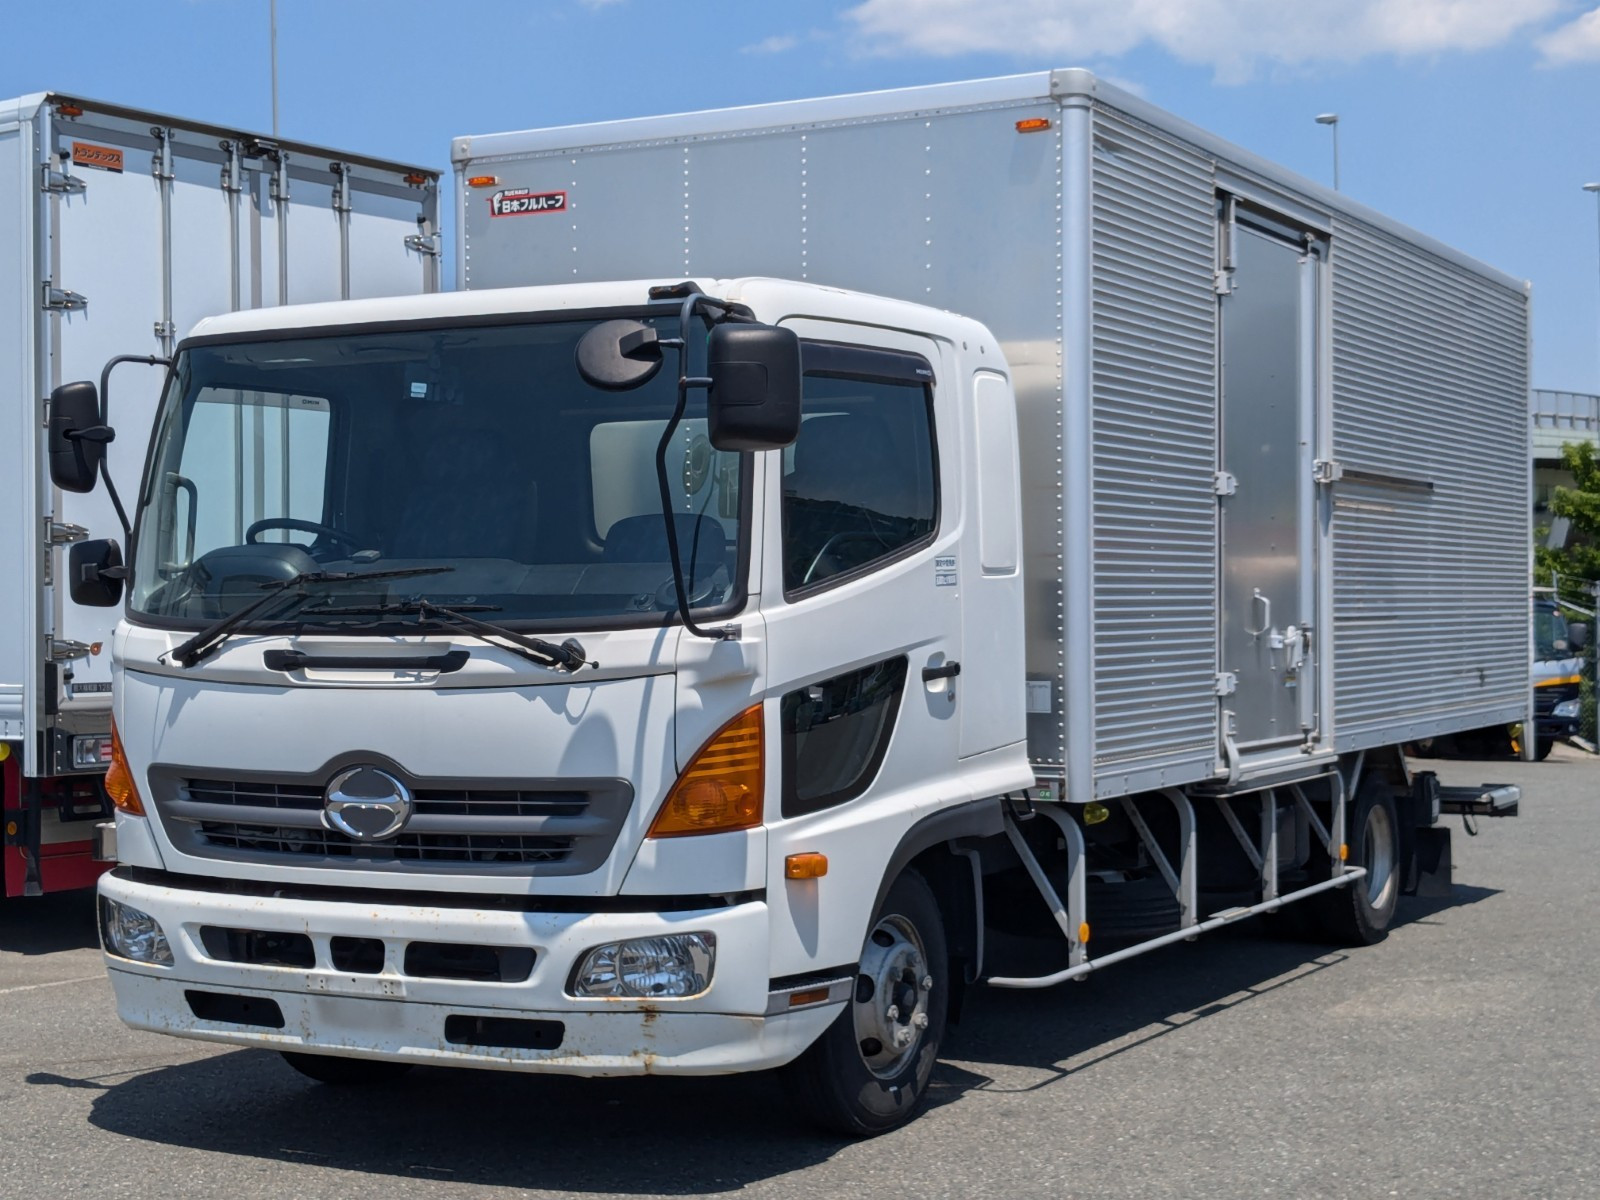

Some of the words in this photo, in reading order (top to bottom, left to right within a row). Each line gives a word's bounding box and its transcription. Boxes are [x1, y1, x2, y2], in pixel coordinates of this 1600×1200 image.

[502, 195, 564, 213] 日本フルハーフ
